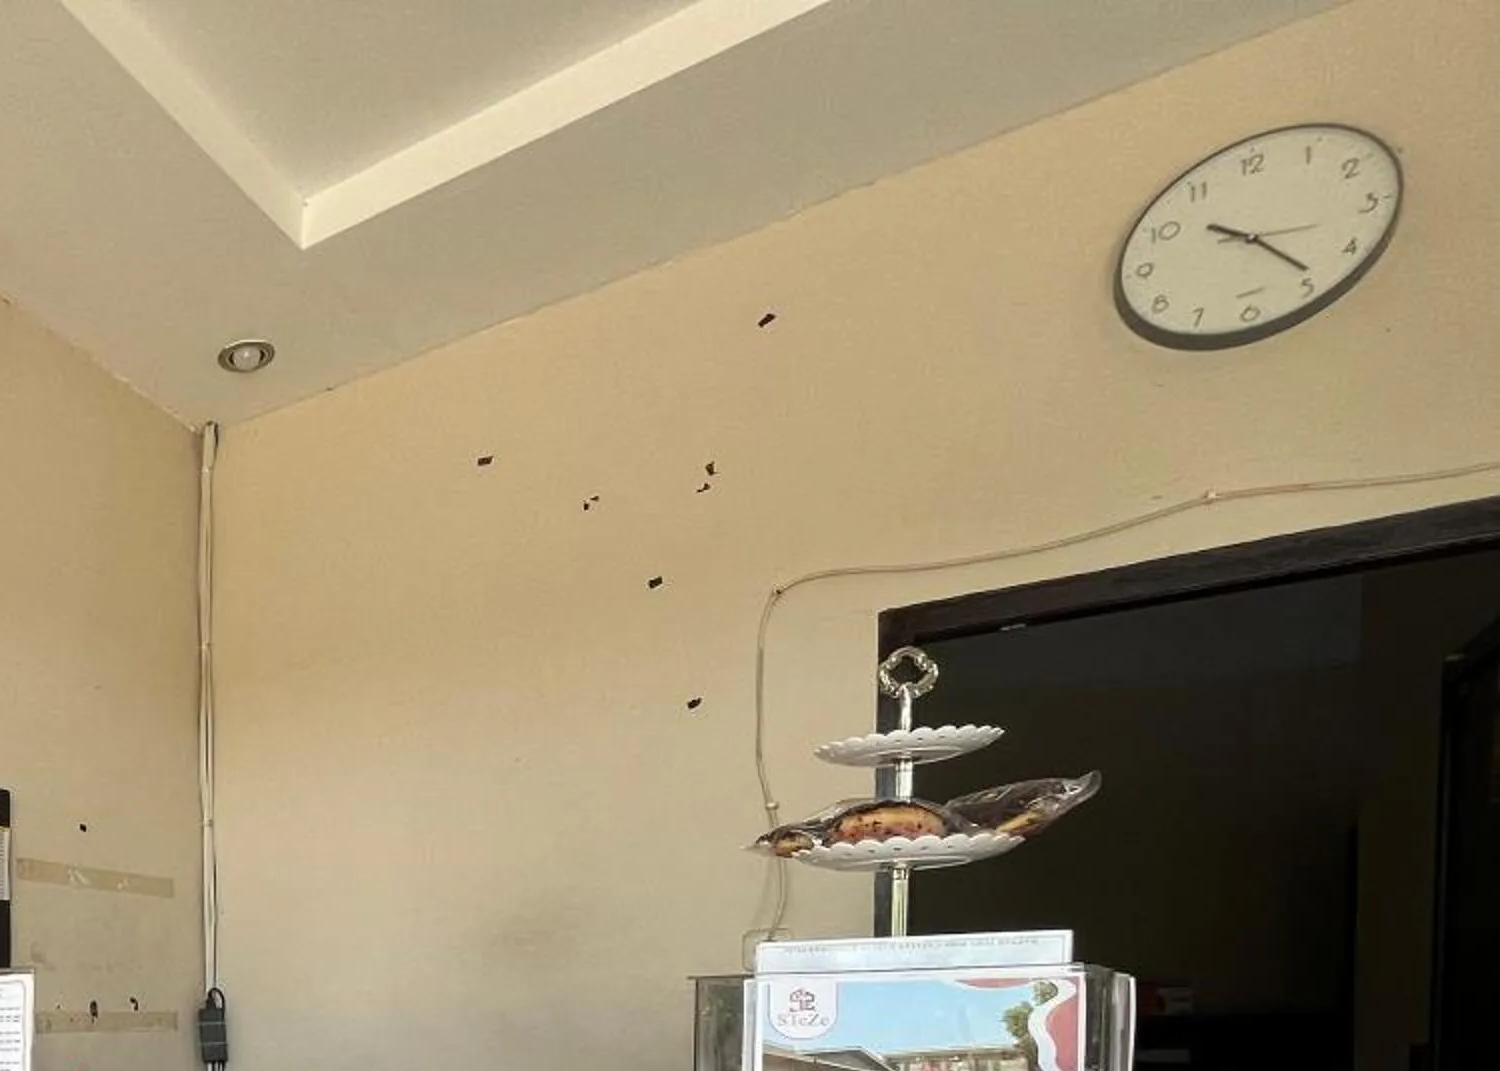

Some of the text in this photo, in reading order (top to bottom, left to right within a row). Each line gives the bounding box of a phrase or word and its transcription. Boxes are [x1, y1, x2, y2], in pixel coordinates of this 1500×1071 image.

[1241, 154, 1264, 176] 12
[1341, 157, 1360, 179] 2
[1188, 181, 1208, 203] 11
[1358, 192, 1379, 214] 3
[1150, 220, 1182, 244] 10
[1342, 236, 1358, 256] 4
[1301, 278, 1315, 299] 5
[1191, 307, 1205, 328] 7
